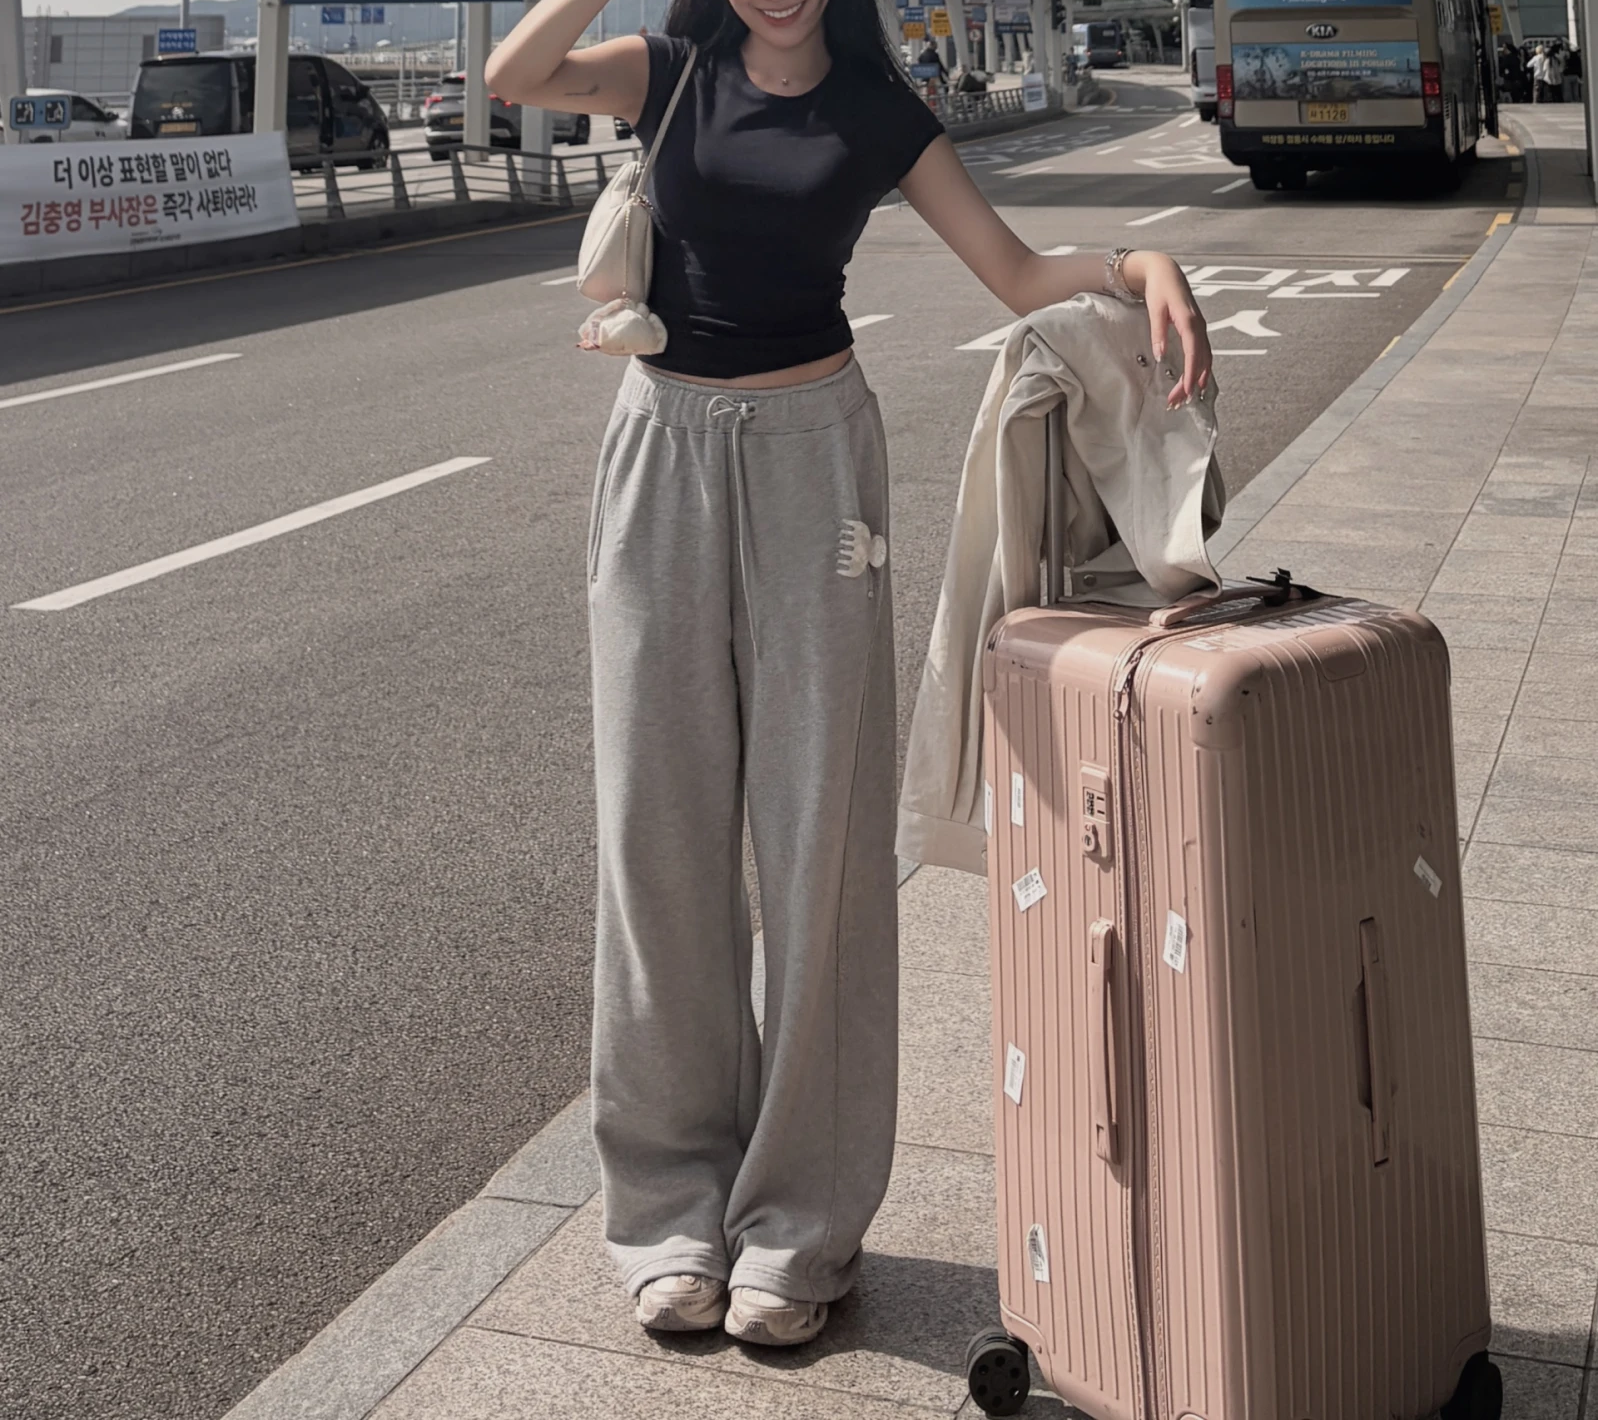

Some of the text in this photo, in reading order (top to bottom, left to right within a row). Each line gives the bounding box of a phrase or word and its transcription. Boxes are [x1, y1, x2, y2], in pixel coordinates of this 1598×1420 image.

[1311, 25, 1335, 37] KIA
[53, 148, 233, 190] 더 이상 표현할 말이 없다
[20, 183, 259, 236] 김충영 부사장은 즉각 사퇴하라!
